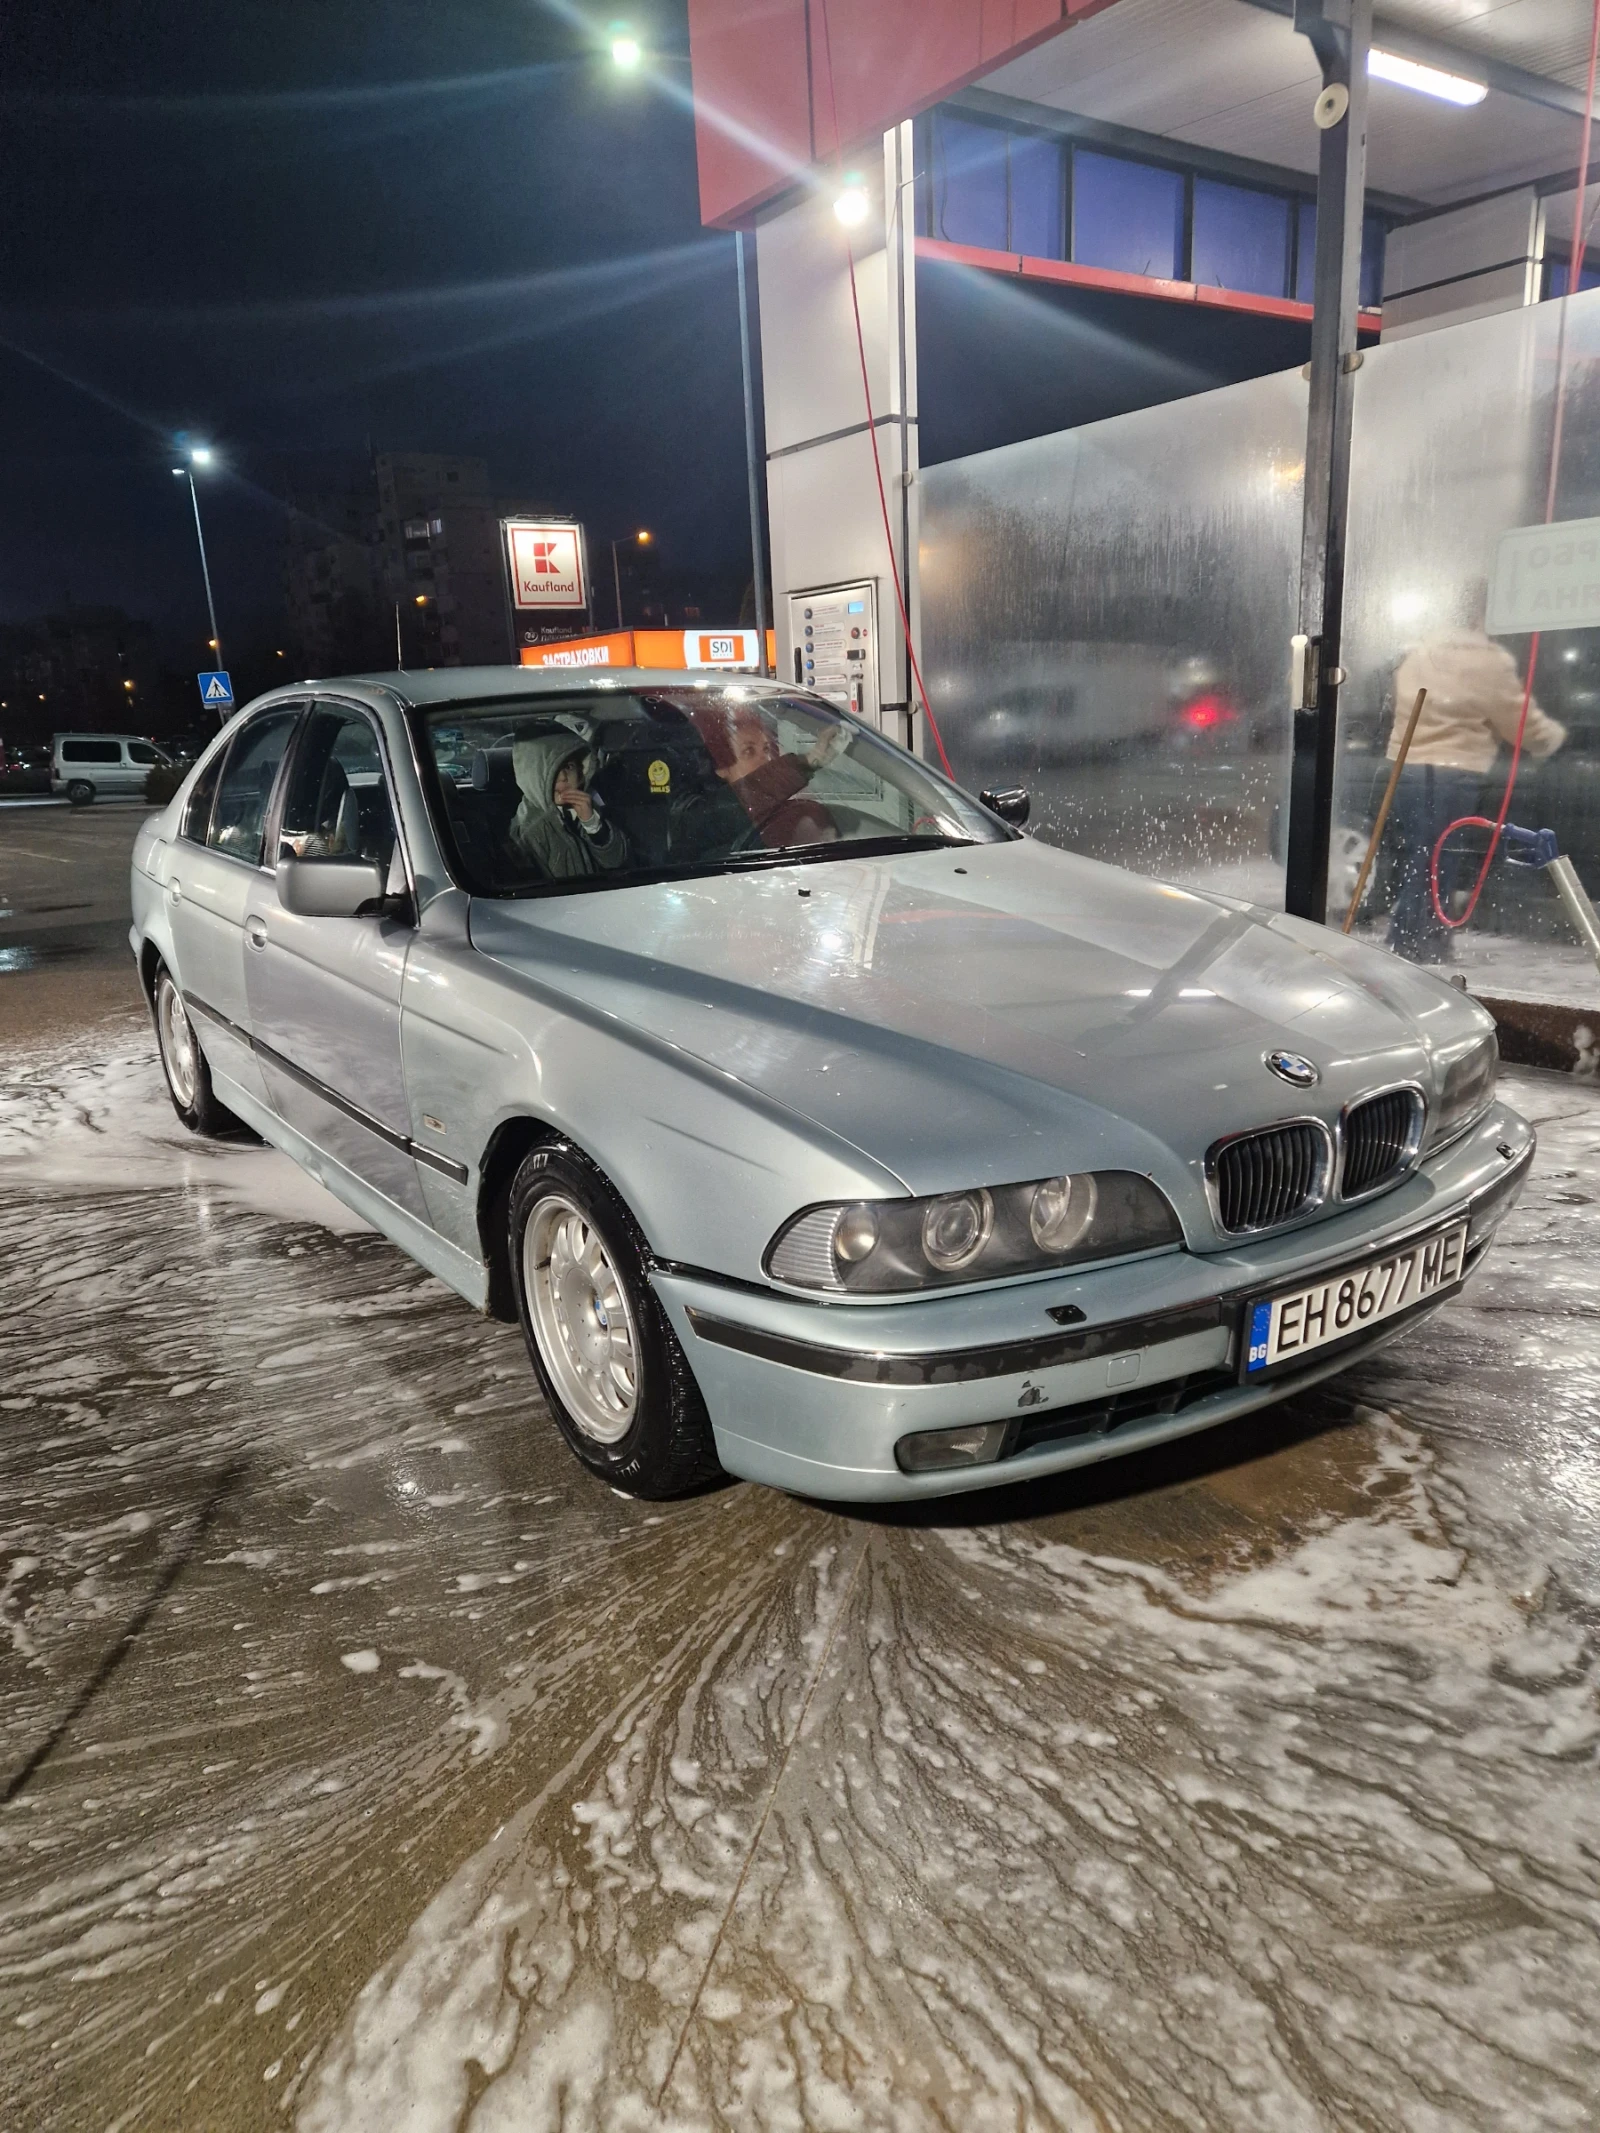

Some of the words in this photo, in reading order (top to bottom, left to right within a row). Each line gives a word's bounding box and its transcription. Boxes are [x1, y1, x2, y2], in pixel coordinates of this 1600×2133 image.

[524, 581, 575, 593] Kaufland
[542, 645, 609, 665] ЗАСТРАХОВКИ
[712, 641, 732, 653] SDI
[1276, 1288, 1330, 1354] EH
[1335, 1251, 1417, 1329] 8677
[1418, 1231, 1462, 1293] ME
[1249, 1344, 1267, 1362] BG
